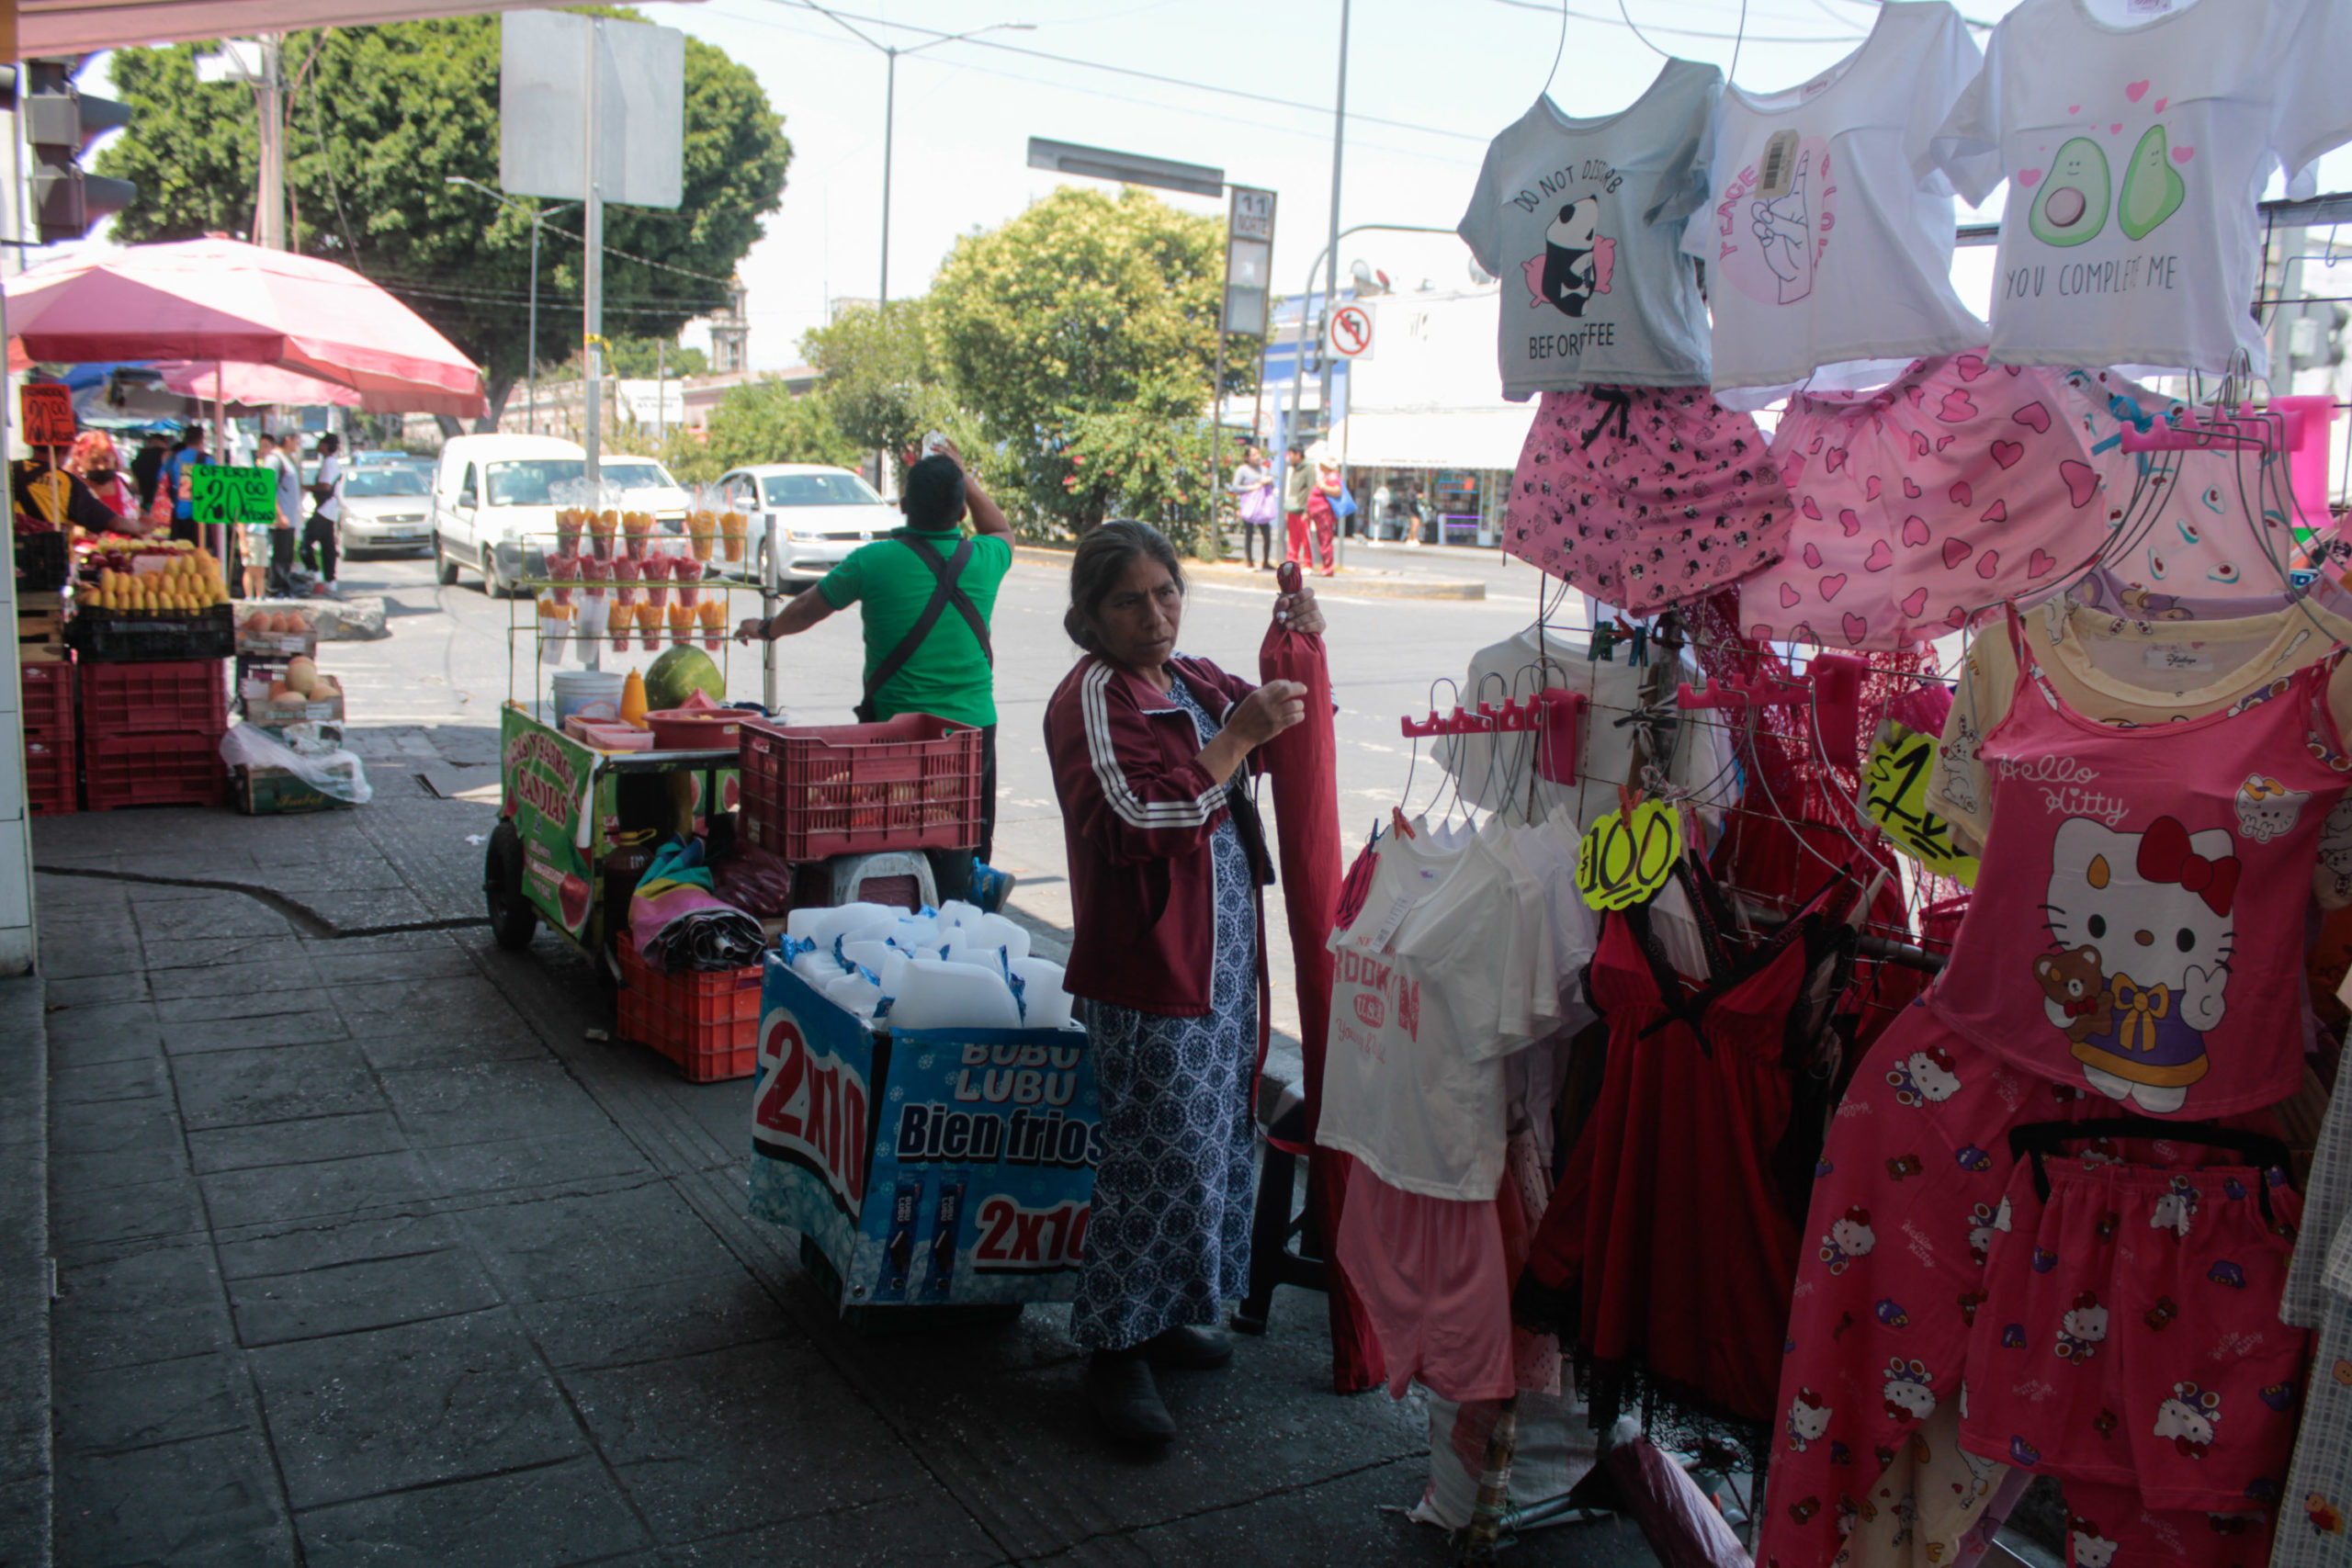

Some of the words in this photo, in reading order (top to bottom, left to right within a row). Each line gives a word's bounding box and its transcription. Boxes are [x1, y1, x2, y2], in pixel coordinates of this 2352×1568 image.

[1242, 194, 1265, 215] 11
[1513, 189, 1540, 214] DO
[1539, 165, 1574, 198] NOT
[1238, 214, 1270, 236] NORTE
[2007, 265, 2045, 299] YOU
[2147, 255, 2177, 289] ME
[199, 466, 263, 479] OFERTA
[1993, 753, 2101, 784] Hello
[518, 765, 568, 827] SANDIAS
[2038, 786, 2130, 827] Kitty
[955, 1069, 1077, 1107] LUBU
[896, 1103, 1002, 1159] Bien
[1005, 1107, 1104, 1164] frios
